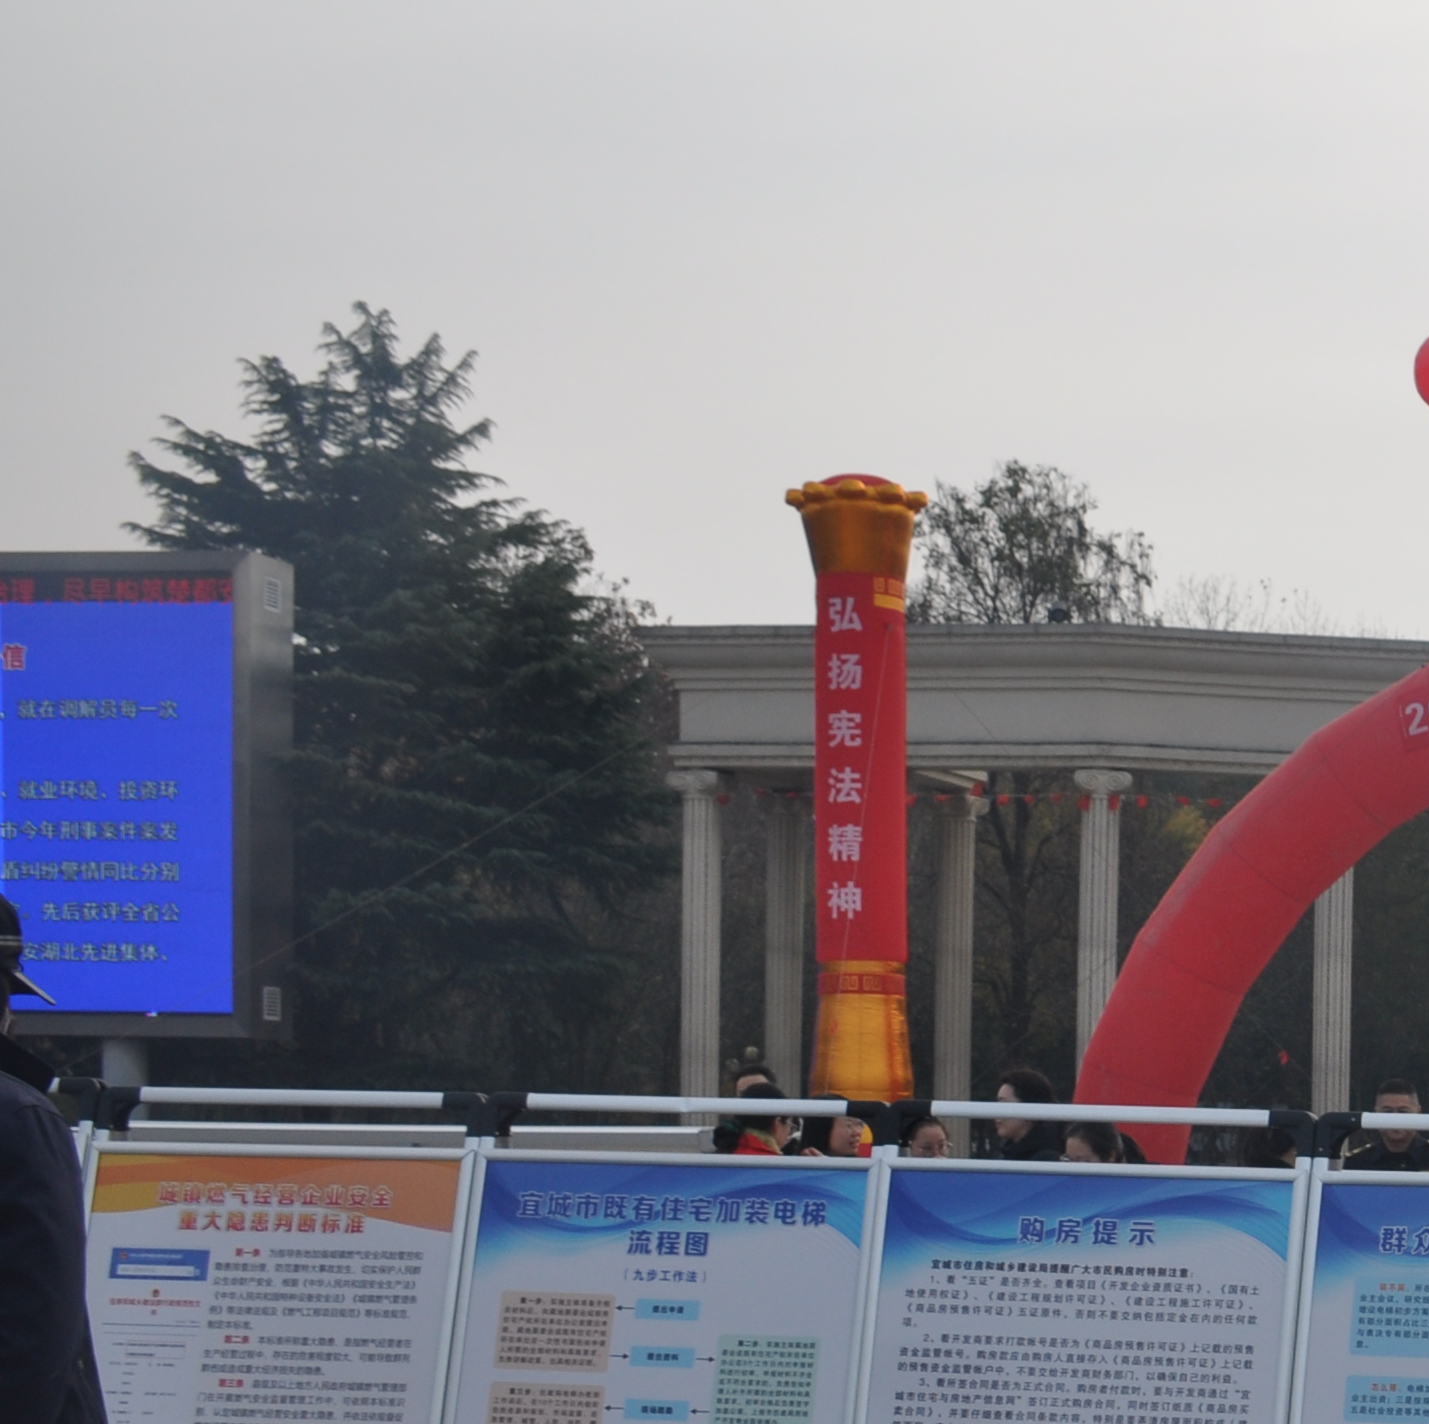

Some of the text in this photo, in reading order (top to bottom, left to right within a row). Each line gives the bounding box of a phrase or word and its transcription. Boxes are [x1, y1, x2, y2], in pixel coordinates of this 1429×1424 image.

[828, 597, 863, 920] 弘扬宪法精神
[11, 902, 180, 922] 。先后获评全省公
[158, 1181, 394, 1209] 城镇燃气经营企业安全
[517, 1191, 827, 1227] 宜城市既有住宅加装电梯
[626, 1230, 710, 1258] 流程图
[1018, 1216, 1155, 1247] 购房提示
